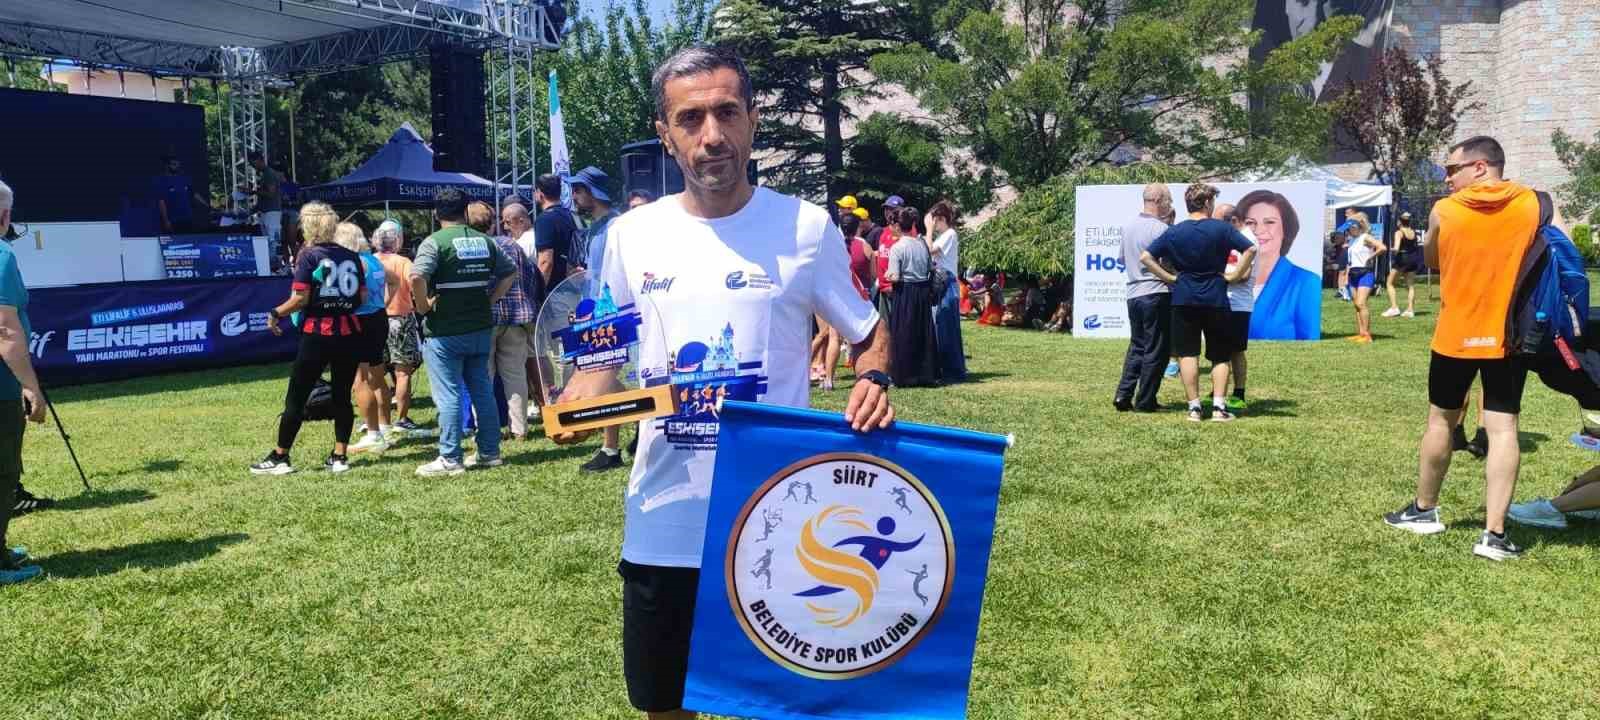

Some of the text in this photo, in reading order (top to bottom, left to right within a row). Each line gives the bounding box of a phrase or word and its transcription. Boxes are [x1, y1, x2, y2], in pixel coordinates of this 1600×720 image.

[319, 258, 359, 297] 26
[1086, 253, 1126, 273] Hoş
[67, 320, 207, 351] ESKİŞEHİR
[833, 465, 878, 488] SİİRT
[750, 599, 918, 664] BELEDİYE SPOR KULÜBÜ
